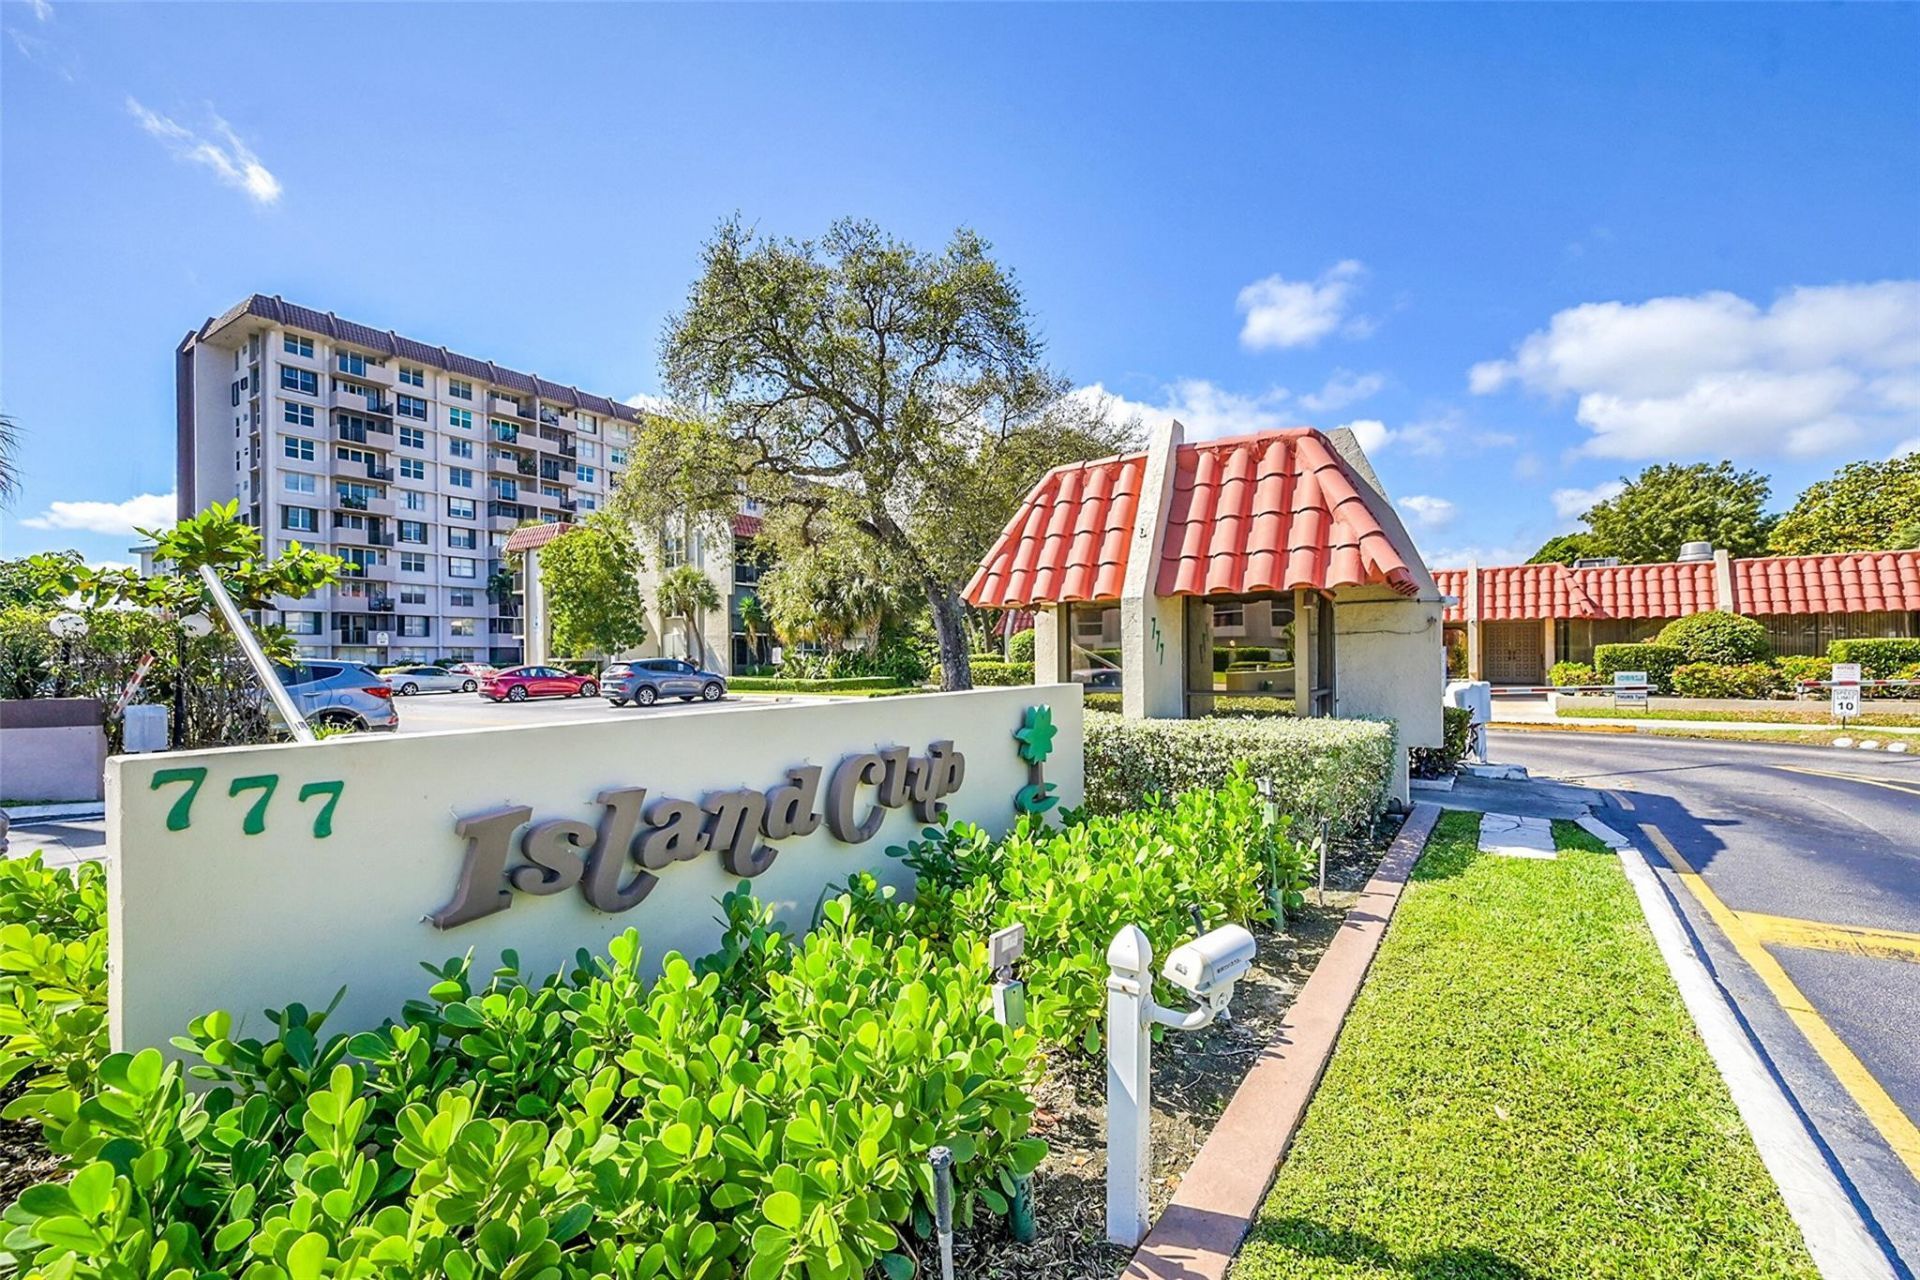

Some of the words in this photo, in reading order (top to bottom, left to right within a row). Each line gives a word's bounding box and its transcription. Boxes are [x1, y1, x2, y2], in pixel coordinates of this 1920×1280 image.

[1151, 617, 1164, 666] 777
[1838, 702, 1854, 711] 10
[151, 767, 344, 839] 777
[432, 765, 822, 931] Island
[828, 740, 965, 844] Club
